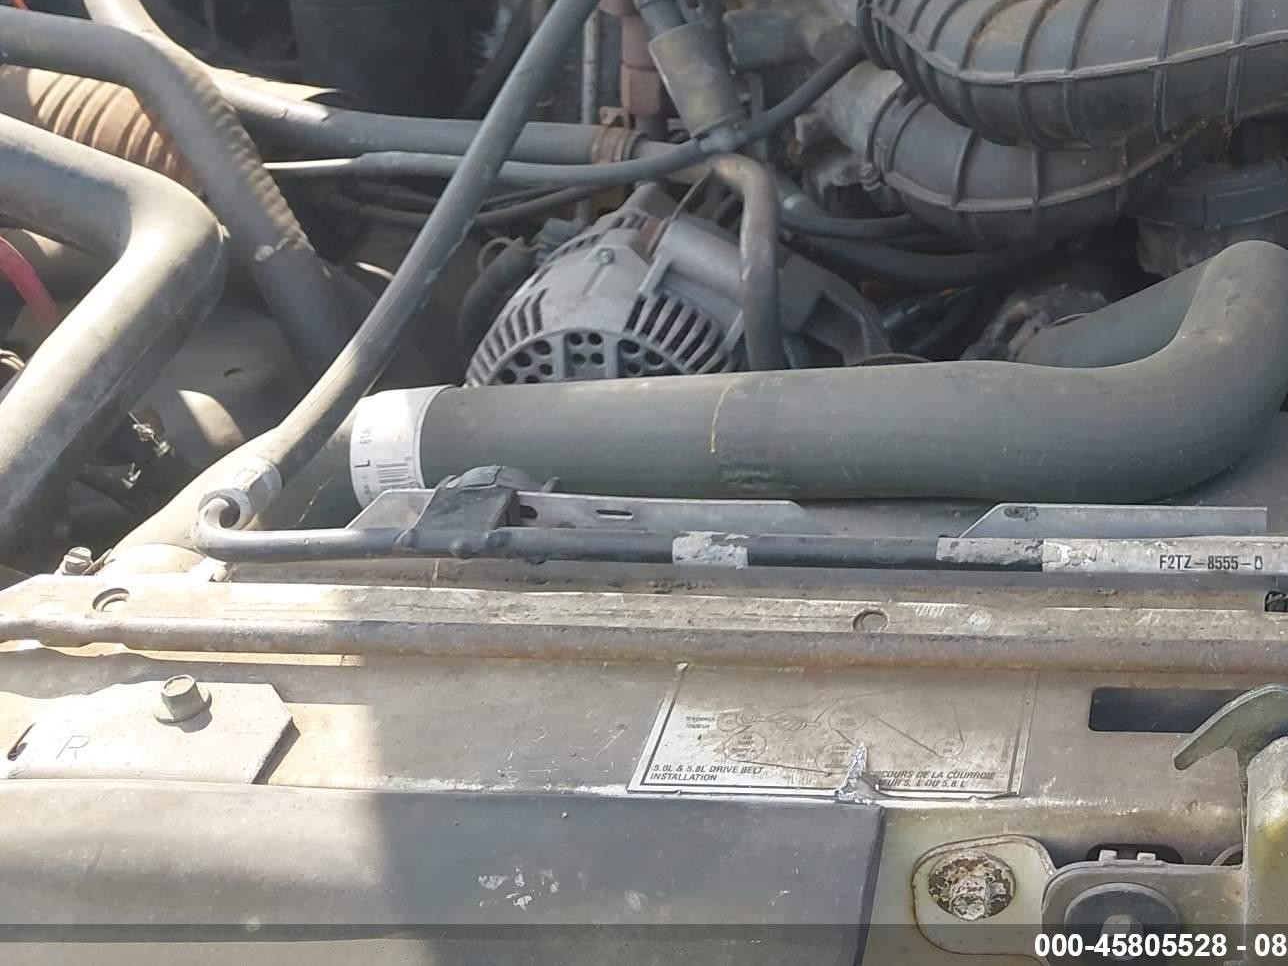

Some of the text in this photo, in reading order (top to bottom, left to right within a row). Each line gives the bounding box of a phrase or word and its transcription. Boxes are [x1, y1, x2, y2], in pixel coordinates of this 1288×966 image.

[653, 764, 673, 772] 5.0L
[686, 765, 706, 773] 5.8L
[709, 765, 739, 774] DRIVE
[741, 766, 764, 774] BELT
[650, 773, 717, 781] INSTALLATION
[916, 771, 929, 779] DE
